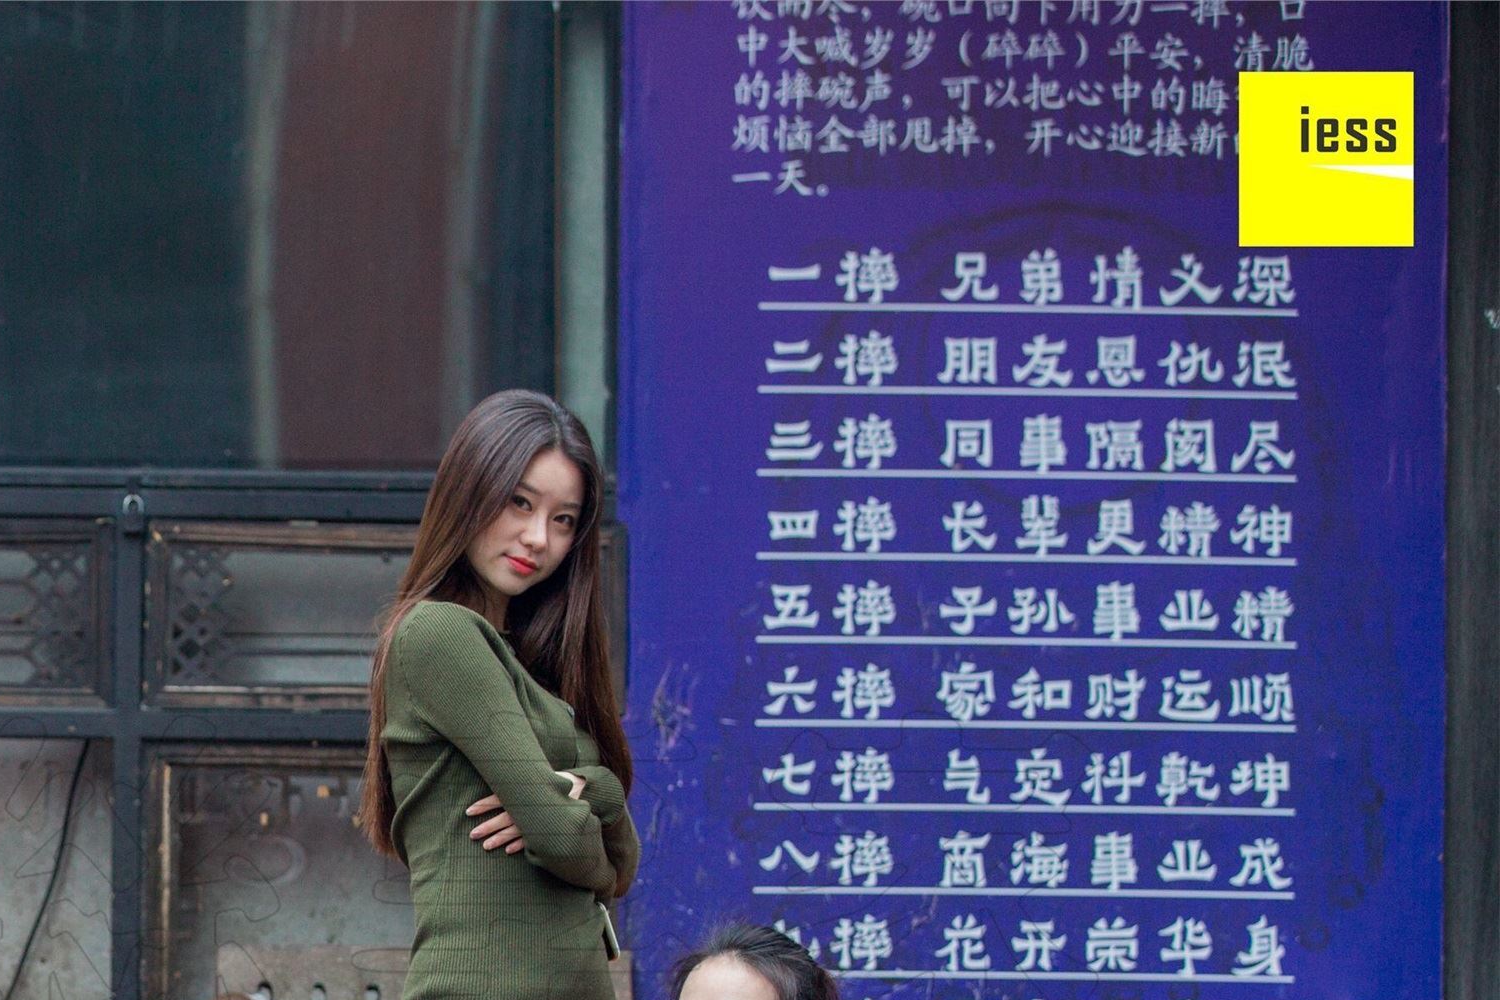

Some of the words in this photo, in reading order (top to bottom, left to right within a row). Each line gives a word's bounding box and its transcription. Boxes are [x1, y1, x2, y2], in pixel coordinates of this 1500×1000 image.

[733, 68, 1239, 115] 的摔碗声，可以把心中的晦
[731, 114, 1239, 160] 烦恼全部甩掉，开心迎接新
